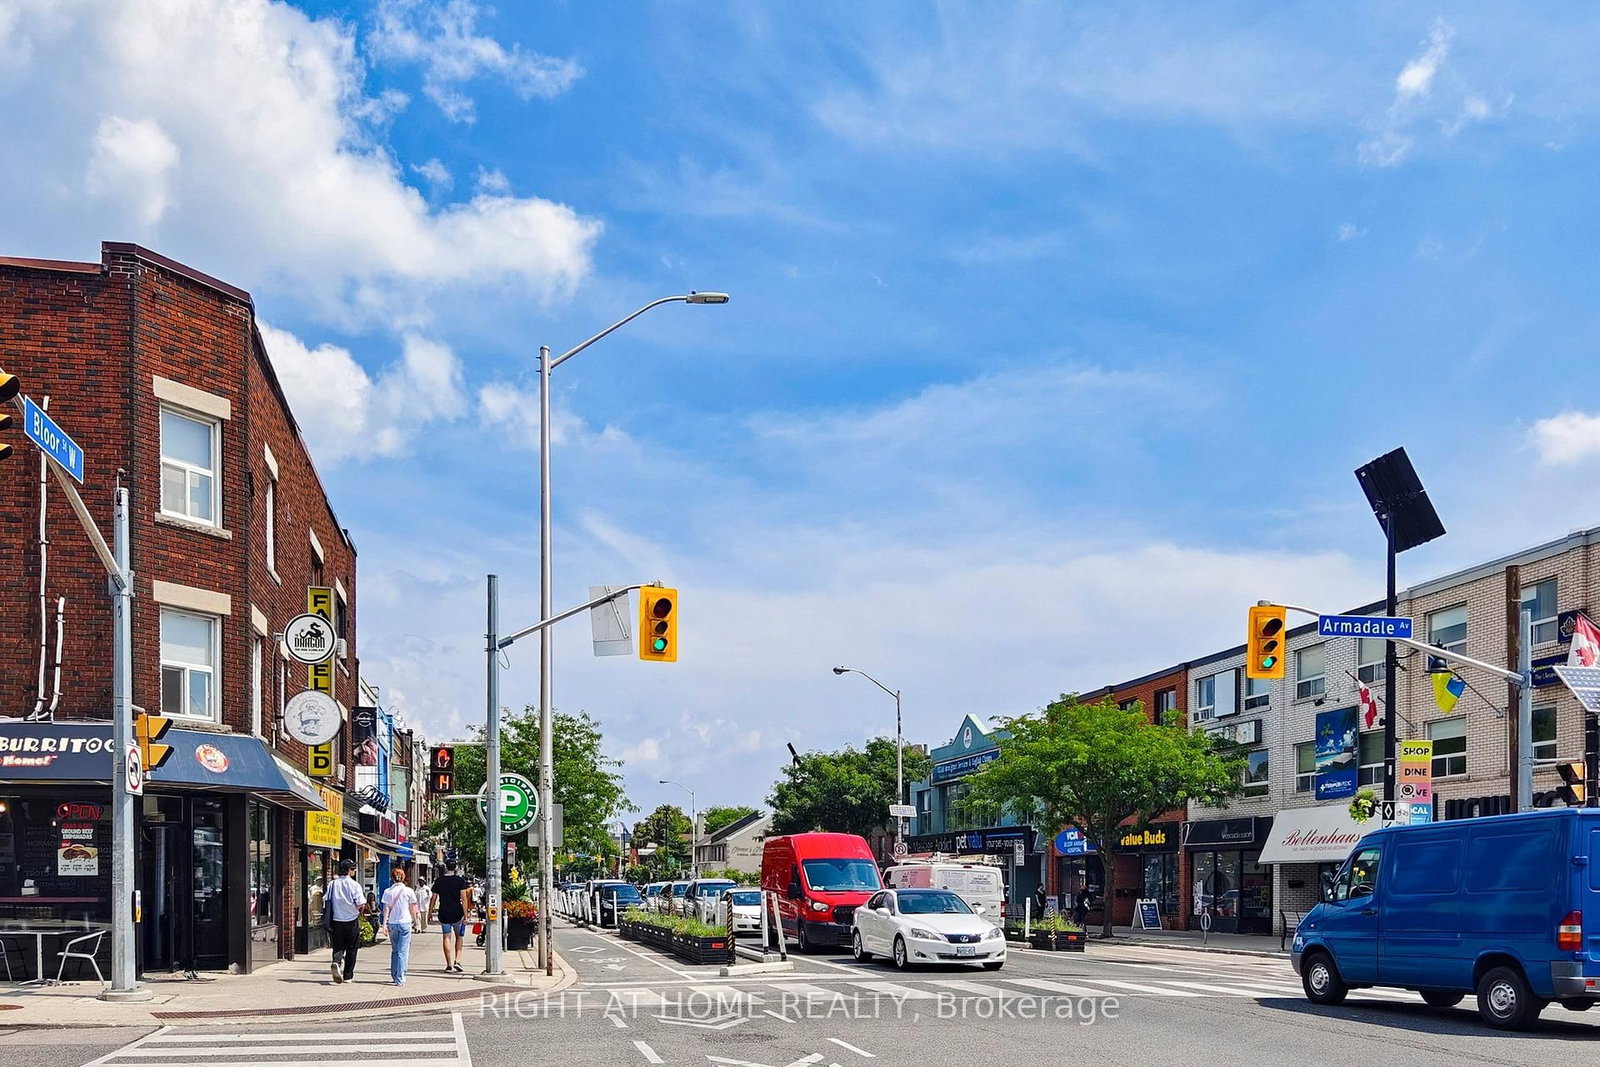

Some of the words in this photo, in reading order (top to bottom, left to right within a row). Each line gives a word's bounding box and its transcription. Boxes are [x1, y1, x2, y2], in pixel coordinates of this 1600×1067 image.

[34, 411, 60, 454] Bloor
[68, 445, 77, 469] W
[1322, 618, 1395, 635] Armadale
[1399, 621, 1409, 629] Av
[1403, 747, 1430, 756] SHOP
[1404, 768, 1428, 776] DINE
[500, 789, 522, 812] P
[956, 833, 967, 854] pet
[1143, 829, 1166, 845] Buds
